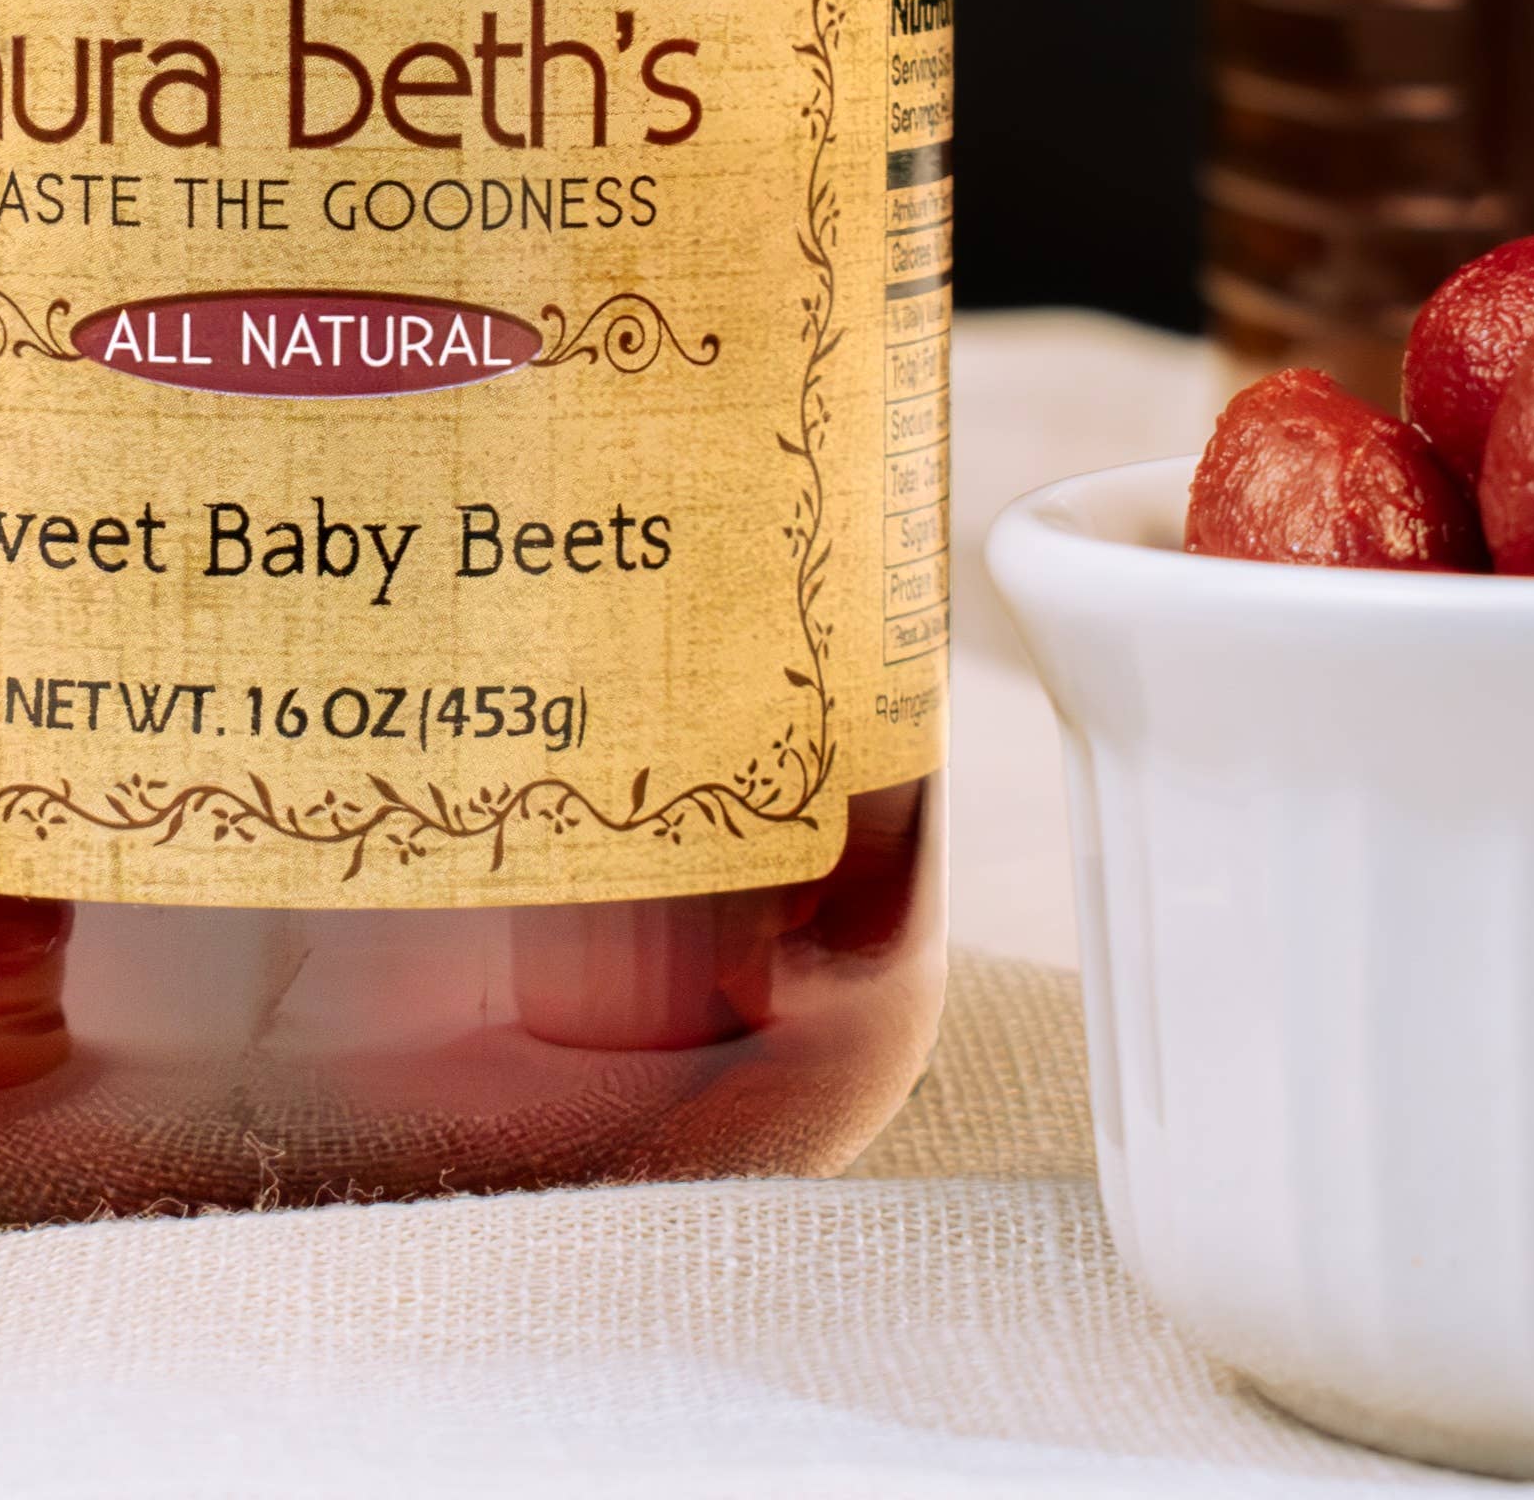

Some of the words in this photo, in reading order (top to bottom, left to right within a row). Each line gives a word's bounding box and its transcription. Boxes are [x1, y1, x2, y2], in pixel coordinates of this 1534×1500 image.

[174, 177, 290, 231] THE
[323, 174, 658, 235] GOODNESS
[102, 309, 214, 367] ALL
[240, 311, 513, 369] NATURAL
[202, 496, 422, 606] Baby
[454, 502, 674, 579] Beets
[4, 676, 112, 731] NET
[118, 682, 227, 737] WT.
[246, 686, 310, 739] 16
